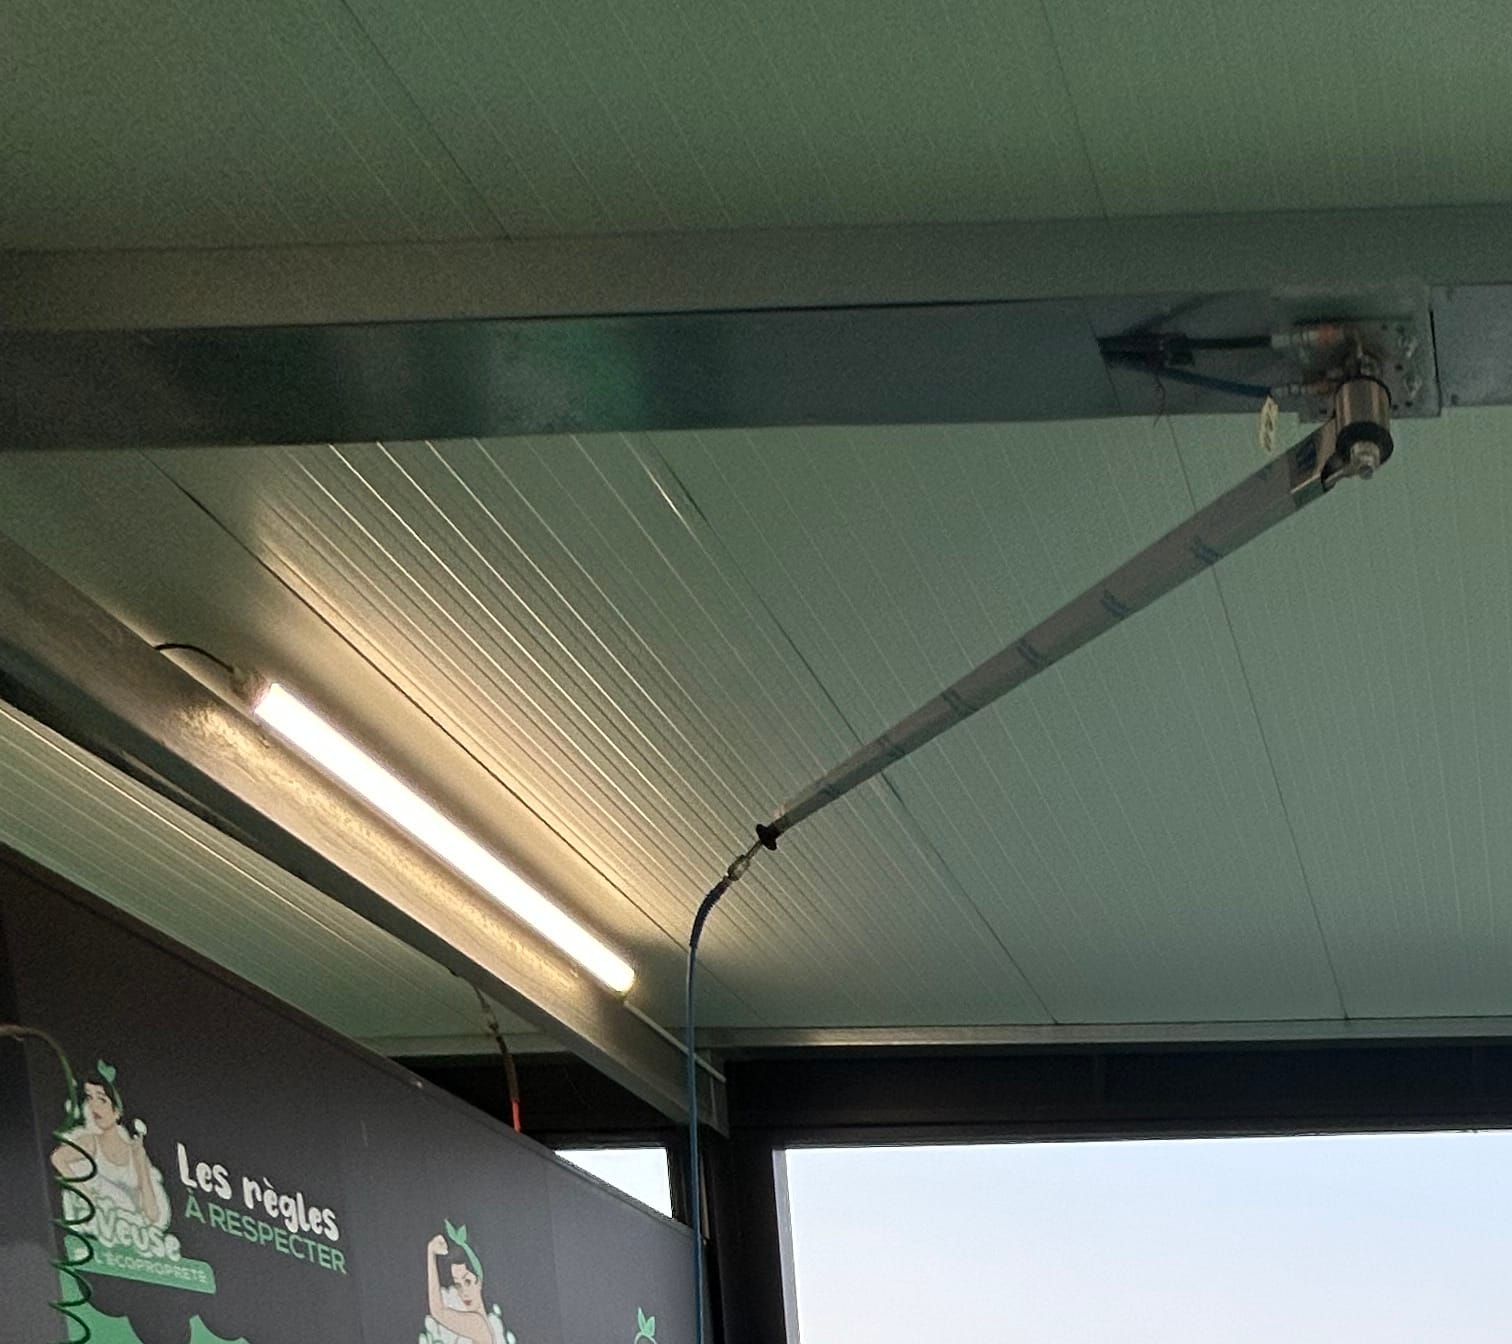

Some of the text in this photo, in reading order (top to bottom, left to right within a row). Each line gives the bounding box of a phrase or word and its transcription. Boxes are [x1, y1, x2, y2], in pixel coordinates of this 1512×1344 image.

[177, 1142, 340, 1241] Les règles
[184, 1188, 347, 1275] À RESPECTER
